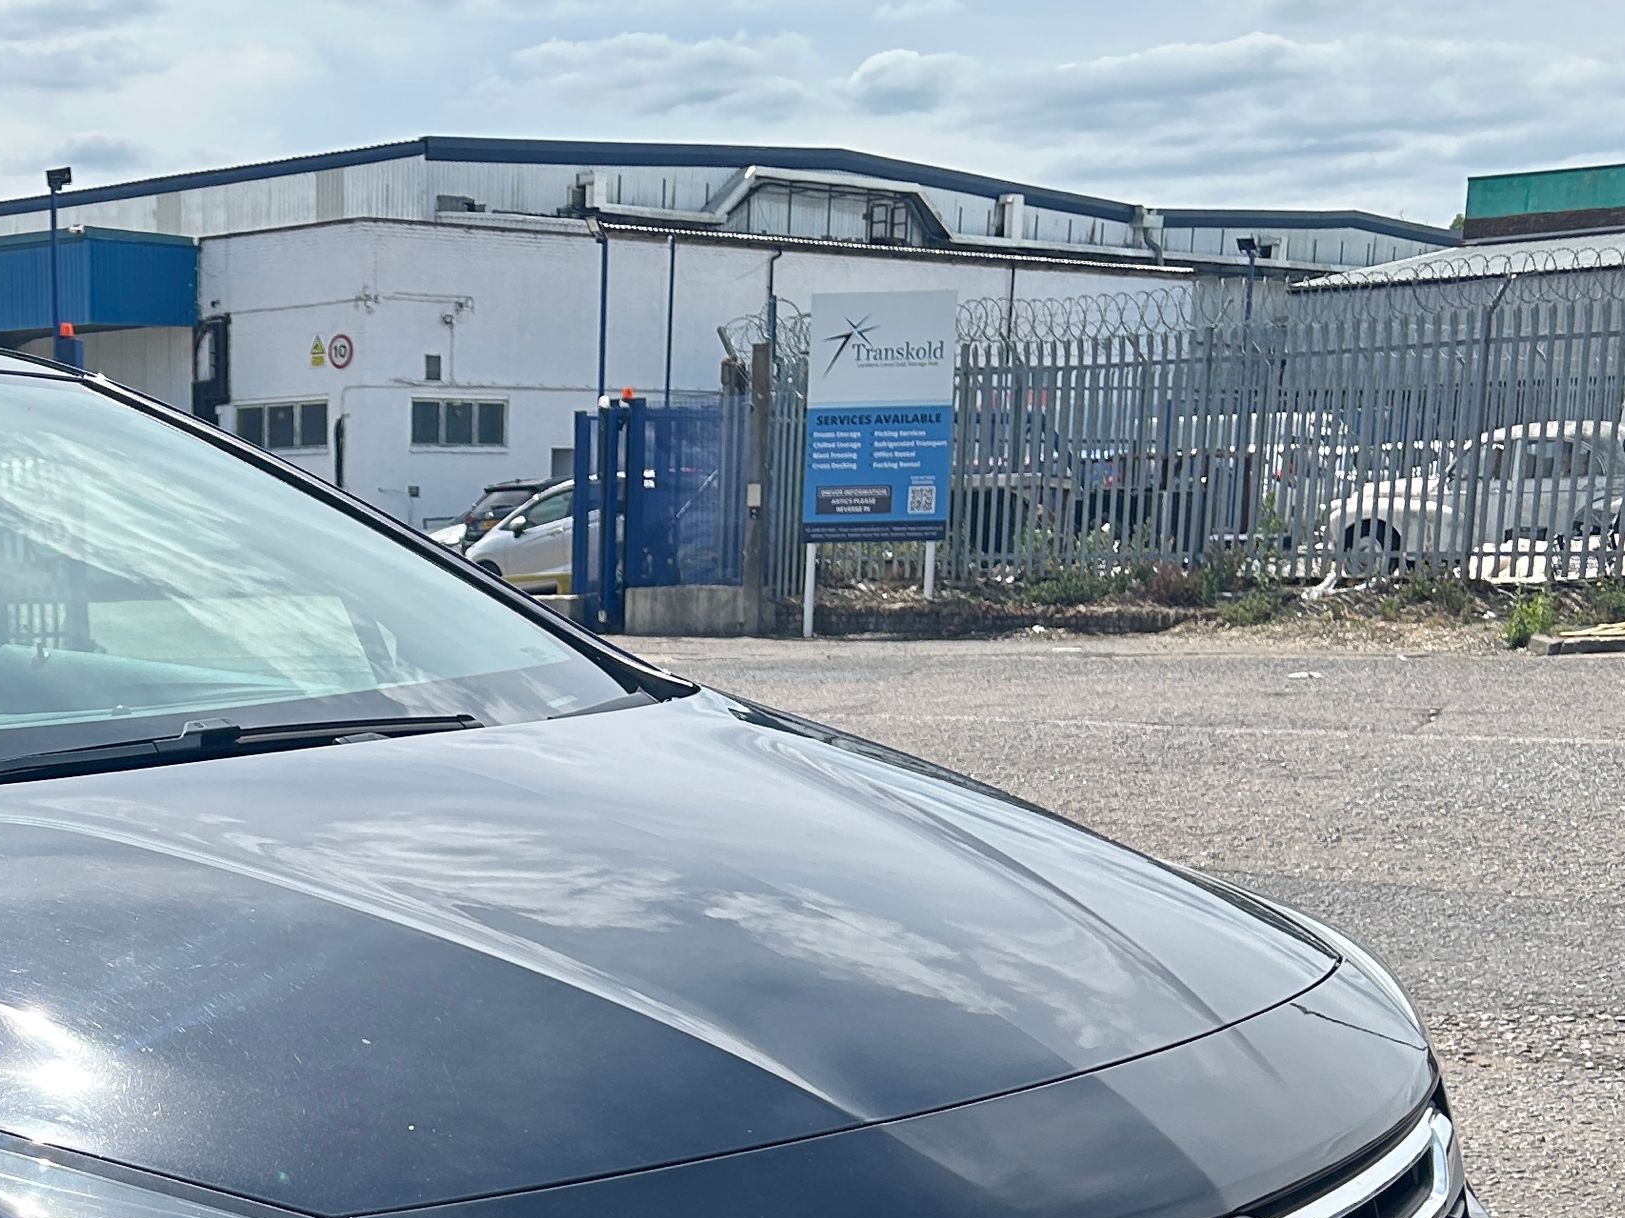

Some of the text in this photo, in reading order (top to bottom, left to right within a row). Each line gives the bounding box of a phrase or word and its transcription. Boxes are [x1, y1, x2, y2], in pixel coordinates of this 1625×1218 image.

[334, 344, 347, 359] 10
[852, 340, 944, 361] Transkold
[816, 412, 942, 426] SERVICES AVAILABLE
